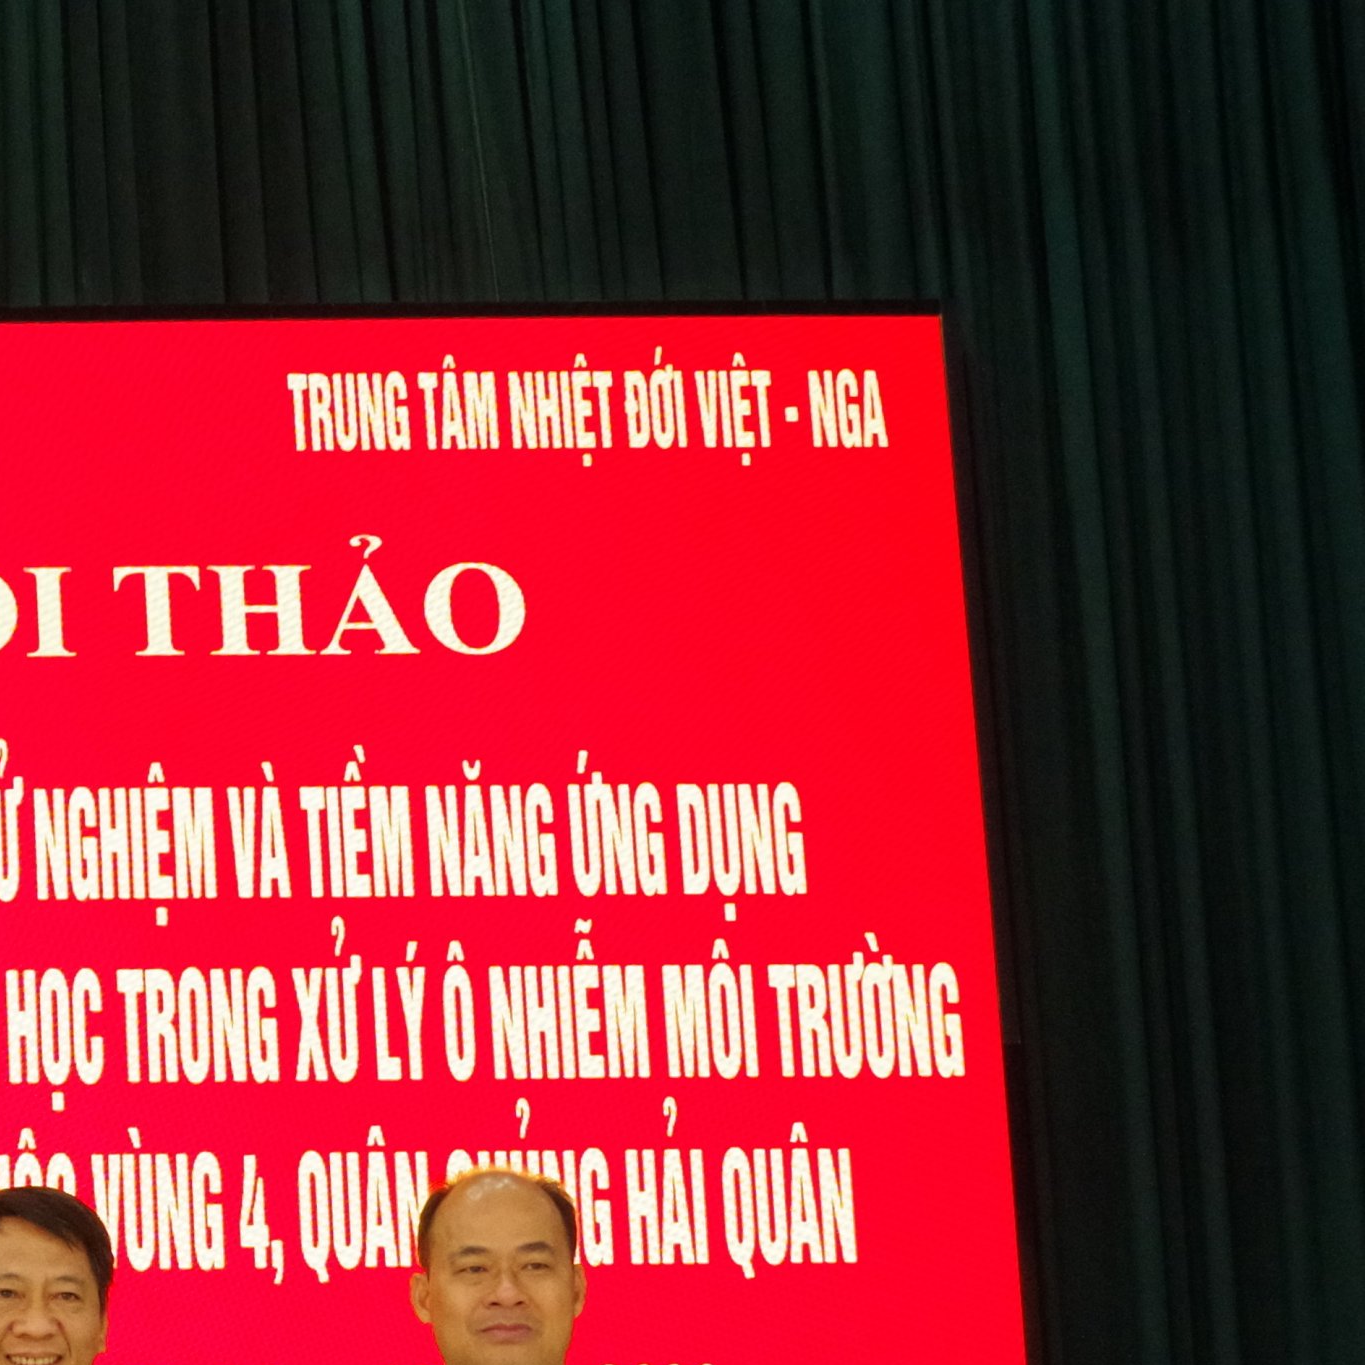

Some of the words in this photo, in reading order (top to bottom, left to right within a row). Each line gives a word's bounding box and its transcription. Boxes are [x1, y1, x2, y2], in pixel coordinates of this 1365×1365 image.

[287, 371, 410, 451] TRUNG
[418, 355, 499, 450] TÂM
[508, 354, 612, 467] NHIỆT
[624, 346, 687, 449] ĐỚI
[695, 352, 771, 466] VIỆT
[785, 407, 798, 422] -
[808, 369, 888, 448] NGA
[113, 535, 525, 656] THẢO
[34, 762, 217, 926] NGHIỆM
[227, 762, 291, 898] VÀ
[299, 745, 414, 898] TIỀM
[425, 760, 557, 897] NĂNG
[567, 750, 667, 896] ỨNG
[676, 782, 807, 921] DỤNG
[6, 968, 104, 1111] HỌC
[116, 966, 279, 1084] TRONG
[292, 916, 362, 1082] XỬ
[372, 941, 425, 1080] LÝ
[443, 941, 476, 1081] Ô
[489, 919, 650, 1079] NHIỄM
[662, 939, 759, 1079] MÔI
[768, 932, 965, 1078] TRƯỜNG
[91, 1127, 225, 1272] VÙNG
[240, 1155, 284, 1284] 4,
[298, 1126, 430, 1286] QUÂN
[625, 1097, 709, 1264] HẢI
[722, 1122, 857, 1279] QUÂN
